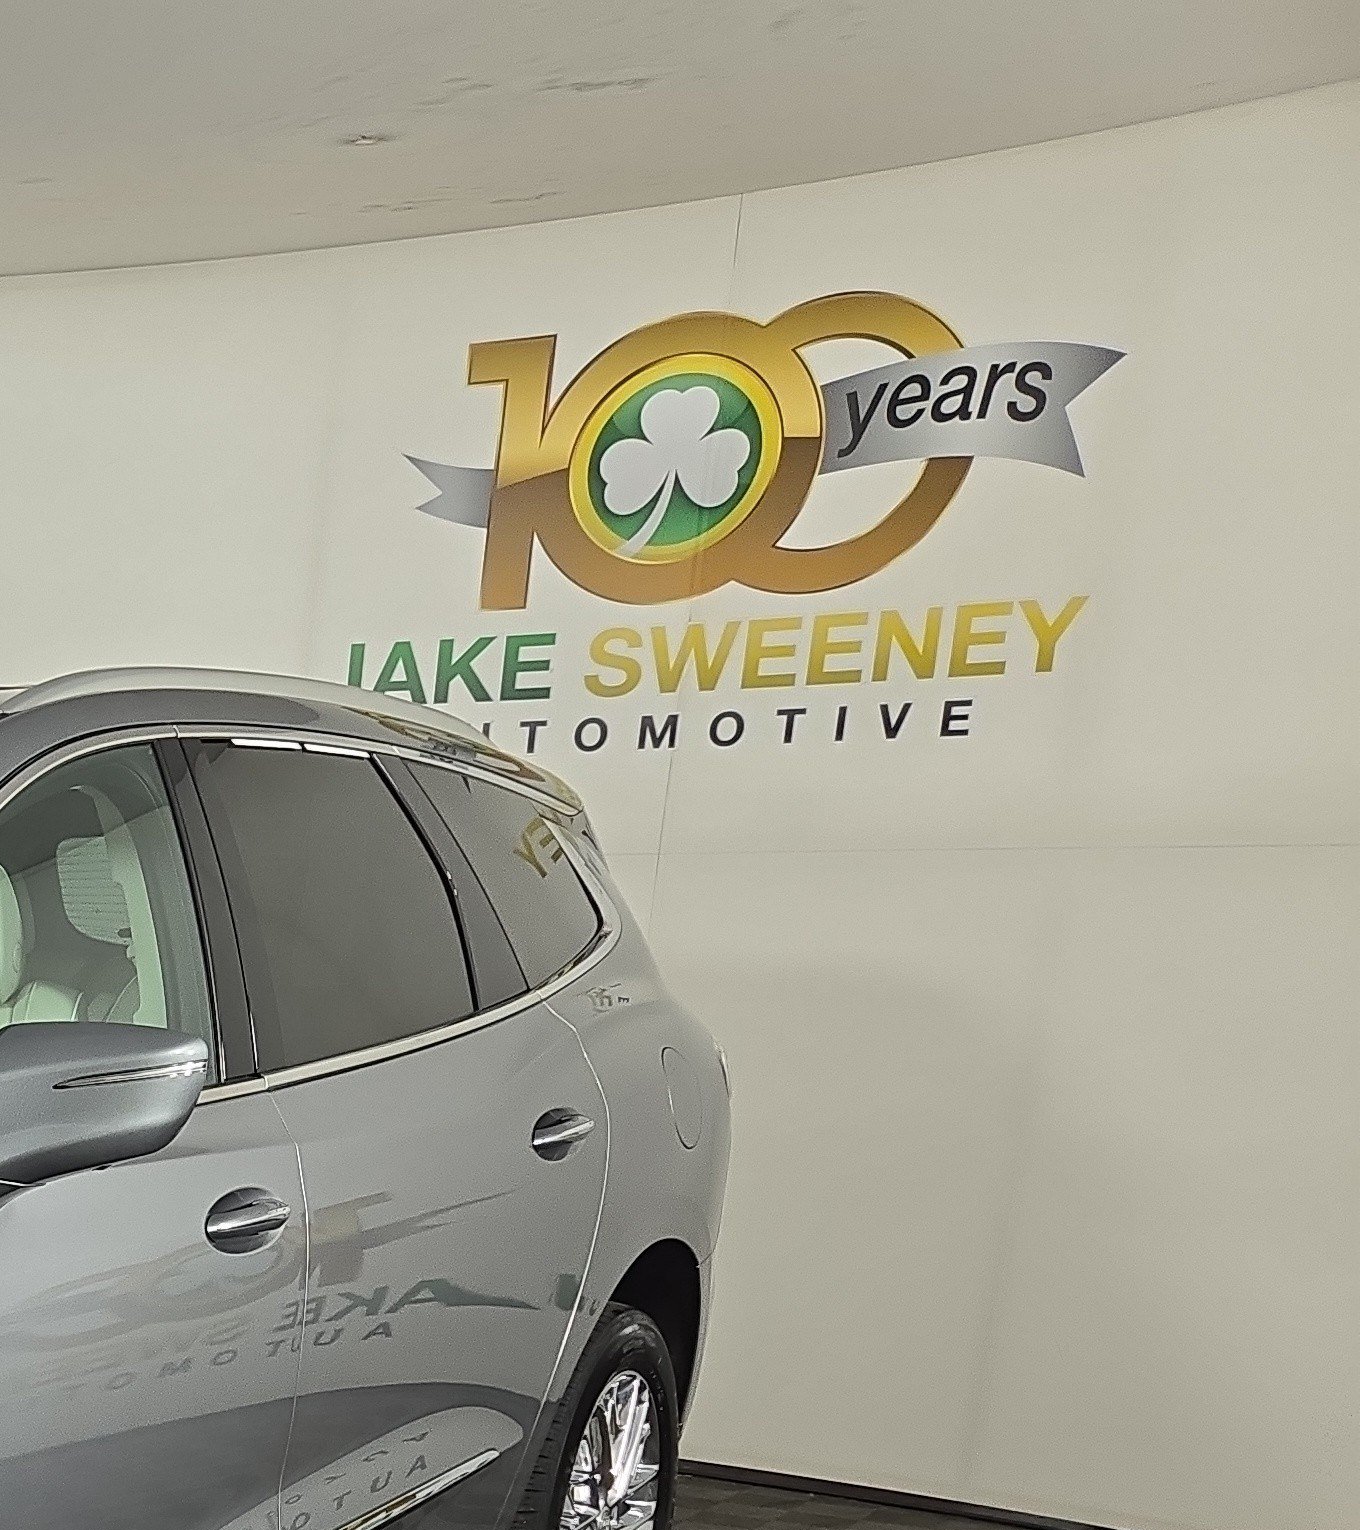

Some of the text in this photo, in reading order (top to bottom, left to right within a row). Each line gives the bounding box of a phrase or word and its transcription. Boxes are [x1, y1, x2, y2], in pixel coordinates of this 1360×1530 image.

[468, 291, 973, 610] 100
[837, 359, 1052, 458] years
[583, 595, 1089, 698] SWEENEY
[482, 698, 975, 755] TOMOTIVE
